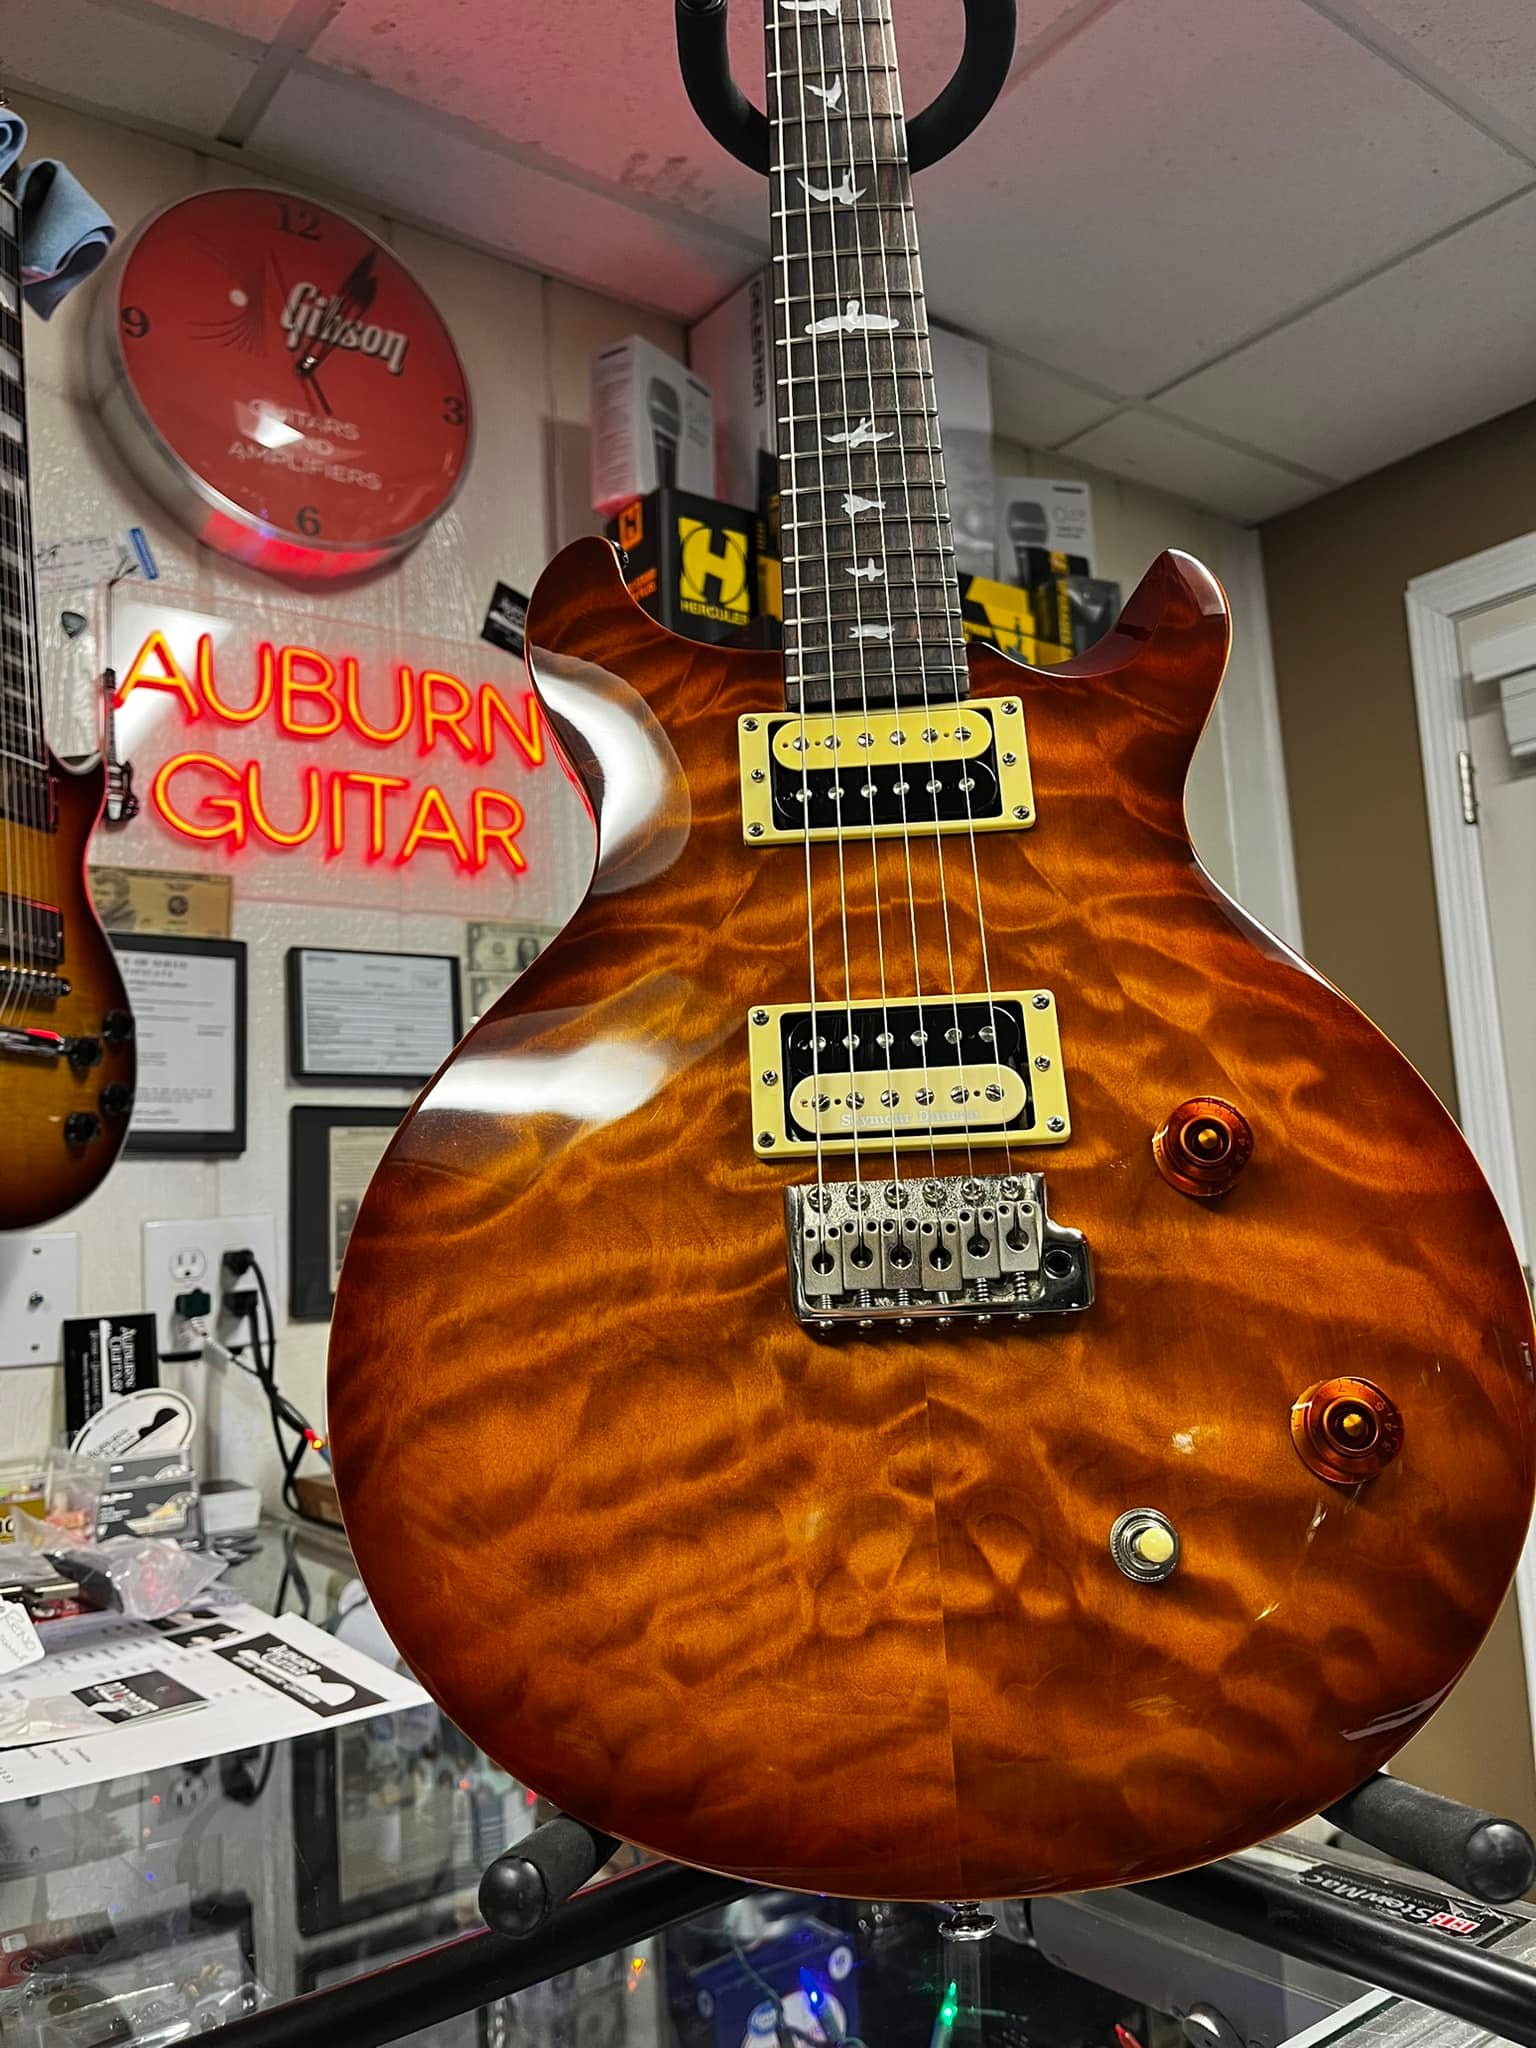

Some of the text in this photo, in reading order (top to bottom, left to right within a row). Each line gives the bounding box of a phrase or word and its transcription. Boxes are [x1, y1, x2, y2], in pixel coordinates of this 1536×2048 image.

[273, 203, 321, 242] 12
[120, 306, 149, 339] 9
[280, 281, 408, 374] Gibson
[247, 398, 361, 441] GITARS
[443, 397, 465, 426] 3
[227, 440, 383, 491] AMPLIFIERS
[296, 506, 322, 537] 6
[679, 599, 751, 627] HERCULES
[112, 629, 546, 767] AUBURN
[151, 751, 528, 873] GUITAR
[1305, 1874, 1436, 1920] StewMac
